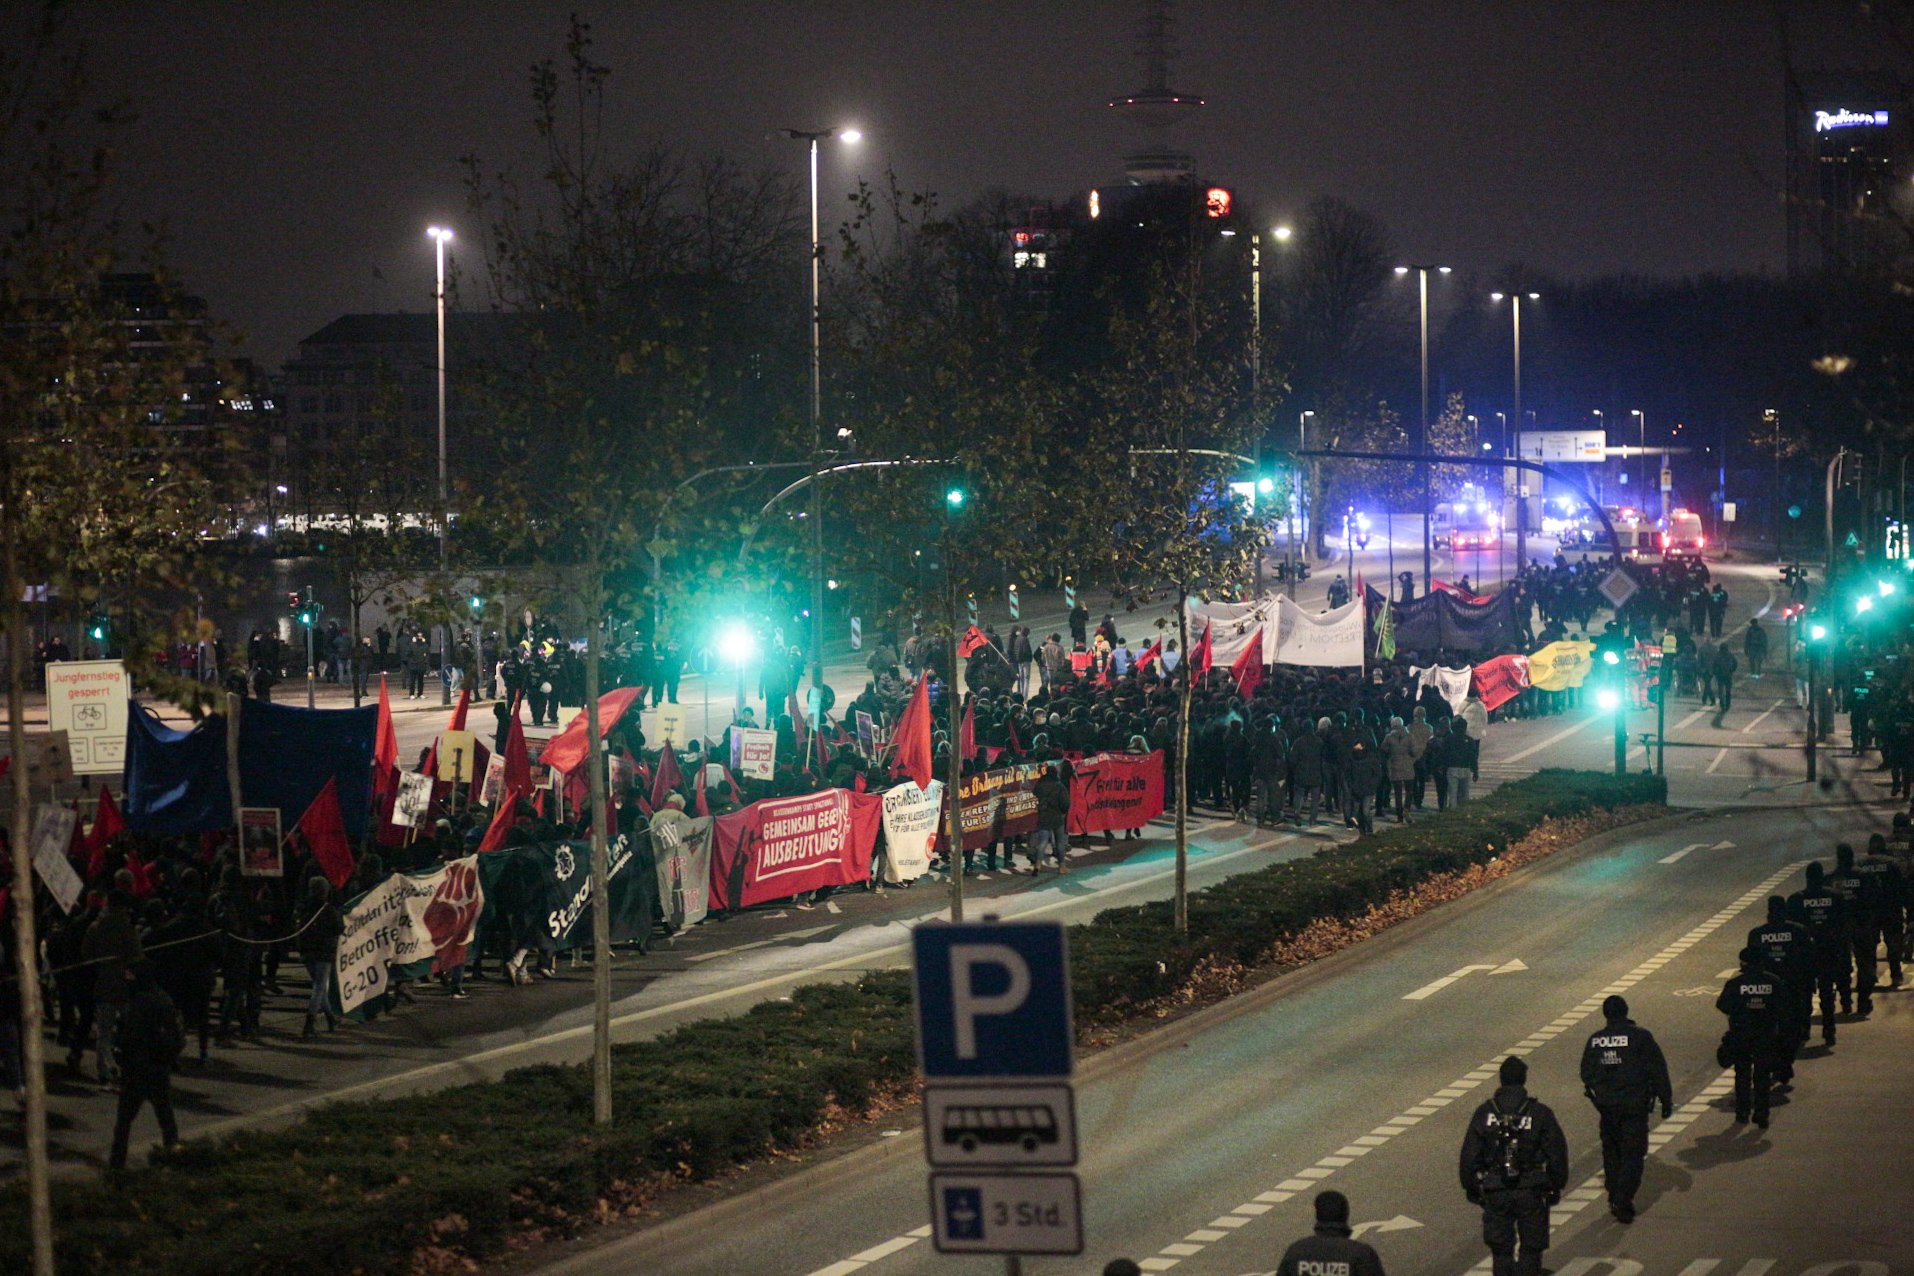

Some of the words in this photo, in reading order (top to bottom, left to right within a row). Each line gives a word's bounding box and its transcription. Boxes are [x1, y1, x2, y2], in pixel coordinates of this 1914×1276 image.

[1815, 107, 1875, 132] Radisson
[55, 671, 121, 685] Jungfernstieg
[67, 687, 111, 700] gesperrt
[746, 751, 758, 760] für
[763, 816, 815, 840] GEMEINSAM
[762, 829, 839, 868] AUSBEUTUNG
[1803, 898, 1832, 908] POLIZEI
[1761, 932, 1792, 943] POLIZEI
[342, 965, 379, 1001] G-20
[1740, 984, 1773, 995] POLIZEI
[950, 942, 1032, 1061] P
[1591, 1036, 1628, 1048] POLIZEI
[993, 1201, 1009, 1227] 3
[1298, 1260, 1350, 1276] POLIZEI
